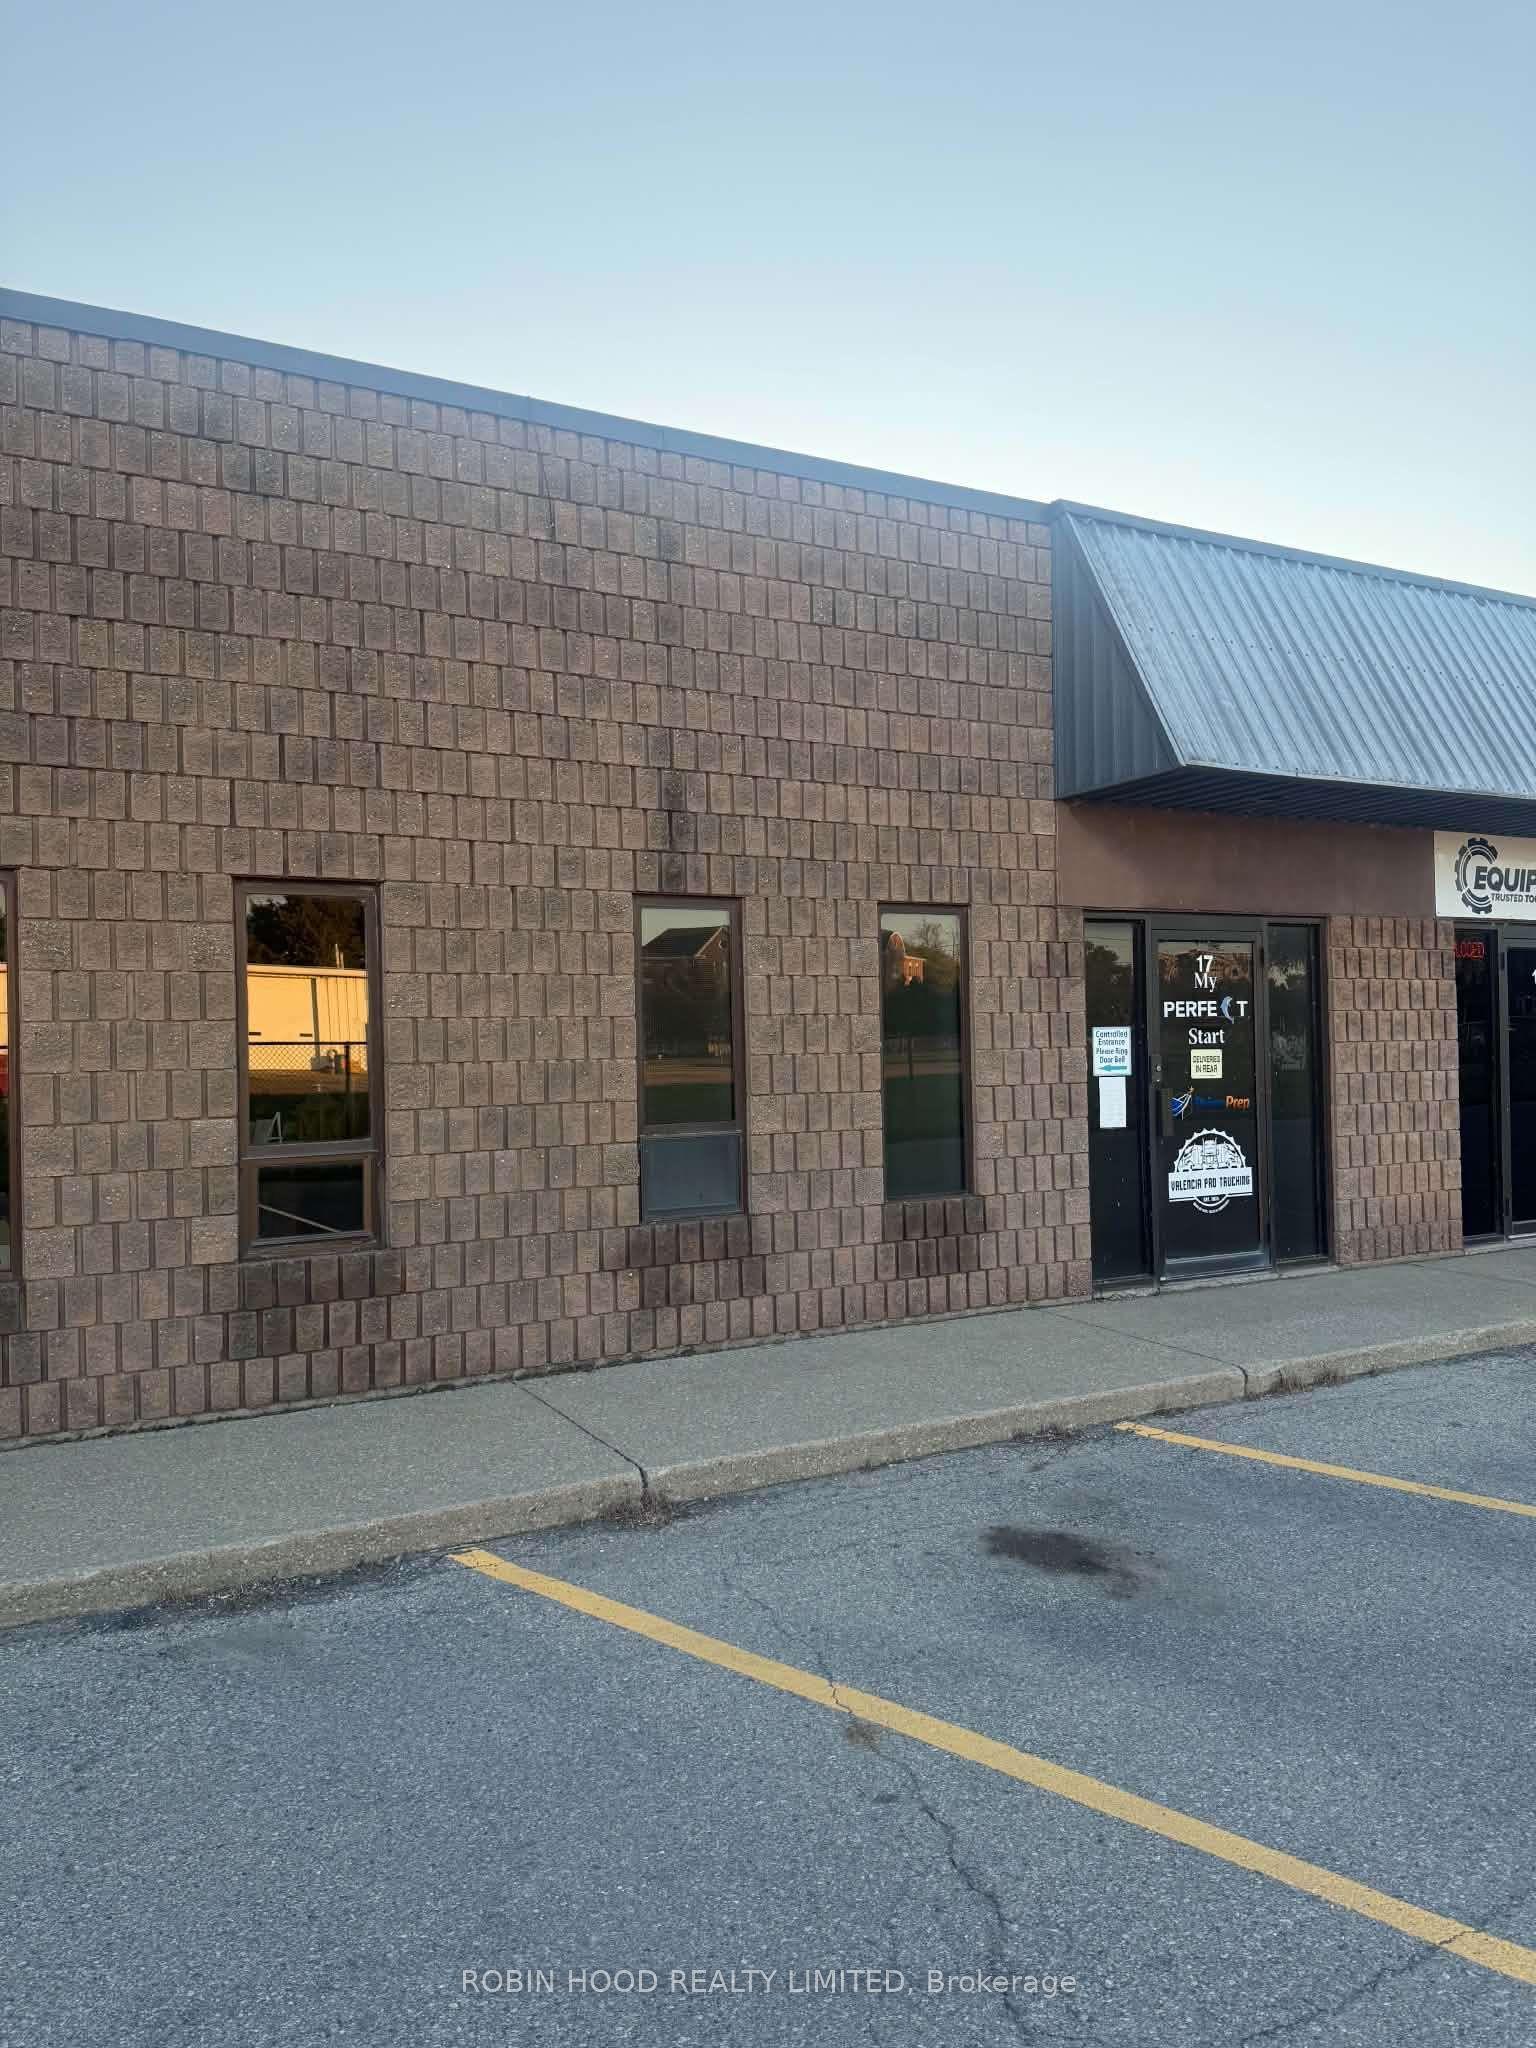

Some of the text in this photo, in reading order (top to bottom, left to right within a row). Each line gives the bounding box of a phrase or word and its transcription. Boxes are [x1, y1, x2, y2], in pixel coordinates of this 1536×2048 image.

[1491, 893, 1523, 902] TRUSTED
[1196, 954, 1214, 972] 17
[1194, 971, 1217, 993] My
[1095, 1030, 1128, 1038] Controlled
[1188, 1027, 1225, 1045] Start
[1098, 1038, 1125, 1046] Entrance
[1099, 1056, 1113, 1064] Door
[1202, 1064, 1218, 1073] REAR
[1171, 1175, 1250, 1191] VALENCIA PRO TRUCKING
